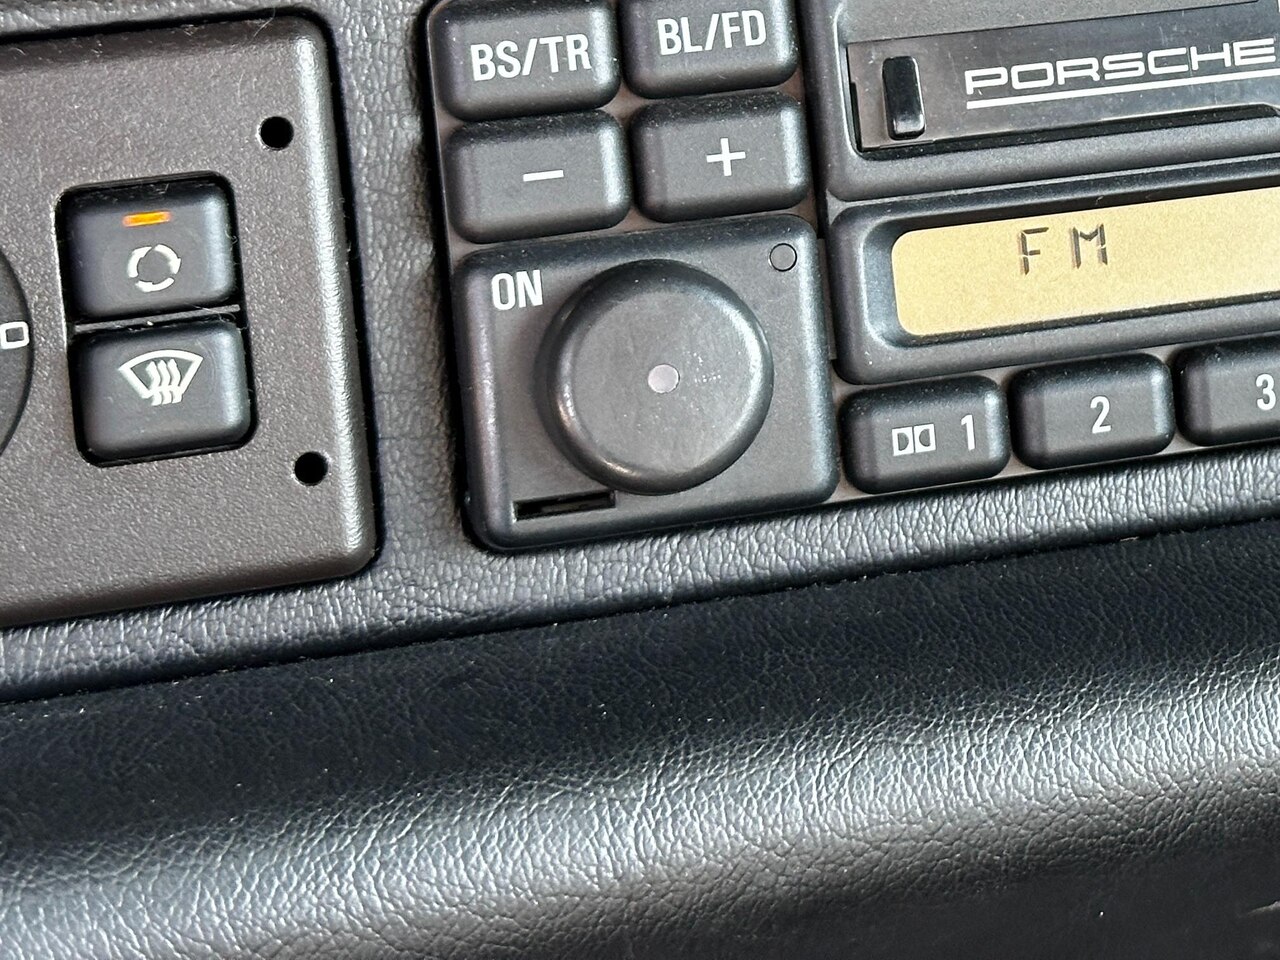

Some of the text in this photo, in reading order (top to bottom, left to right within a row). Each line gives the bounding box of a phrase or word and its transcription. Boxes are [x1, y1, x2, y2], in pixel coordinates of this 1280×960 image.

[657, 9, 767, 55] BL/FD
[470, 33, 592, 81] BS/TR
[964, 38, 1277, 95] PORSCHE
[1017, 222, 1108, 276] FM
[491, 269, 543, 311] ON
[1089, 395, 1112, 433] 2
[1254, 373, 1277, 411] 3
[960, 414, 977, 451] 1
